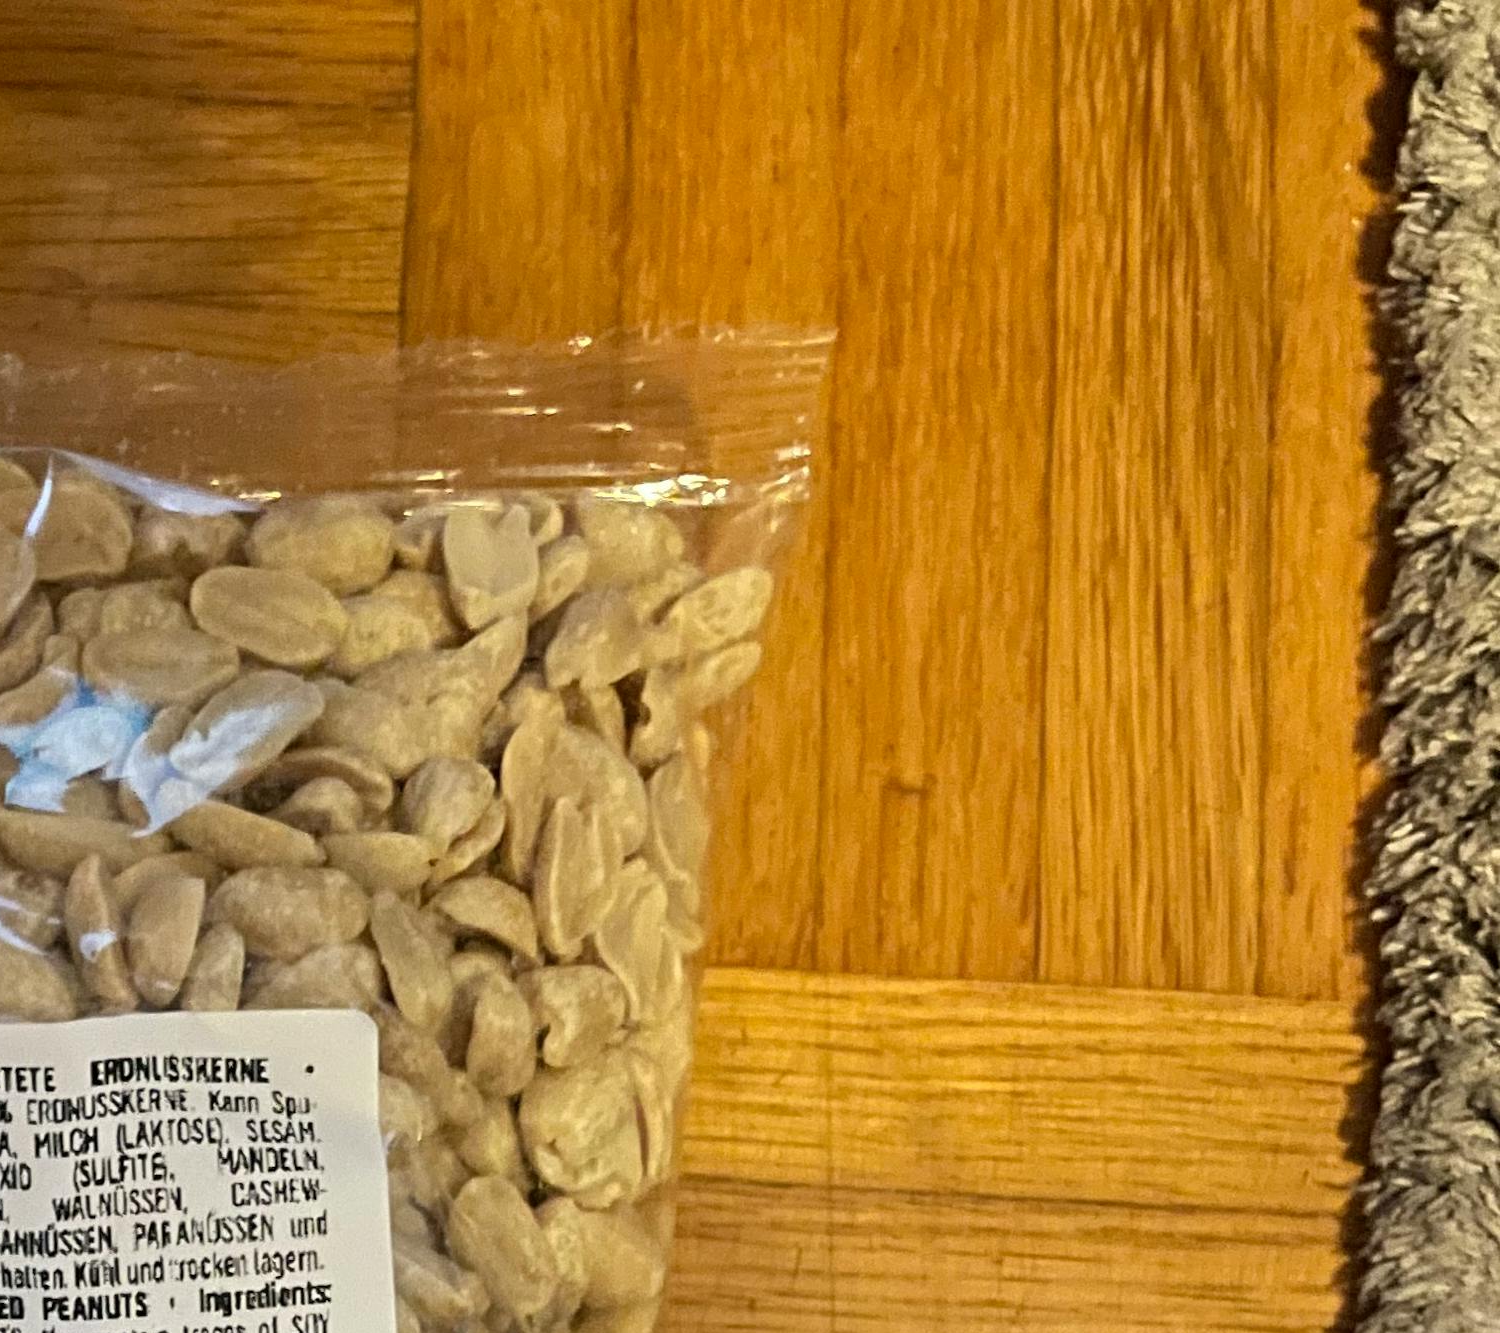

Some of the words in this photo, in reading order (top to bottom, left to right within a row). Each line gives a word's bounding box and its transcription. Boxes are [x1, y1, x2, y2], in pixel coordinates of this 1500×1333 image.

[33, 1125, 100, 1160] MILCH
[289, 1208, 328, 1239] und
[41, 1290, 149, 1322] PEANUTS
